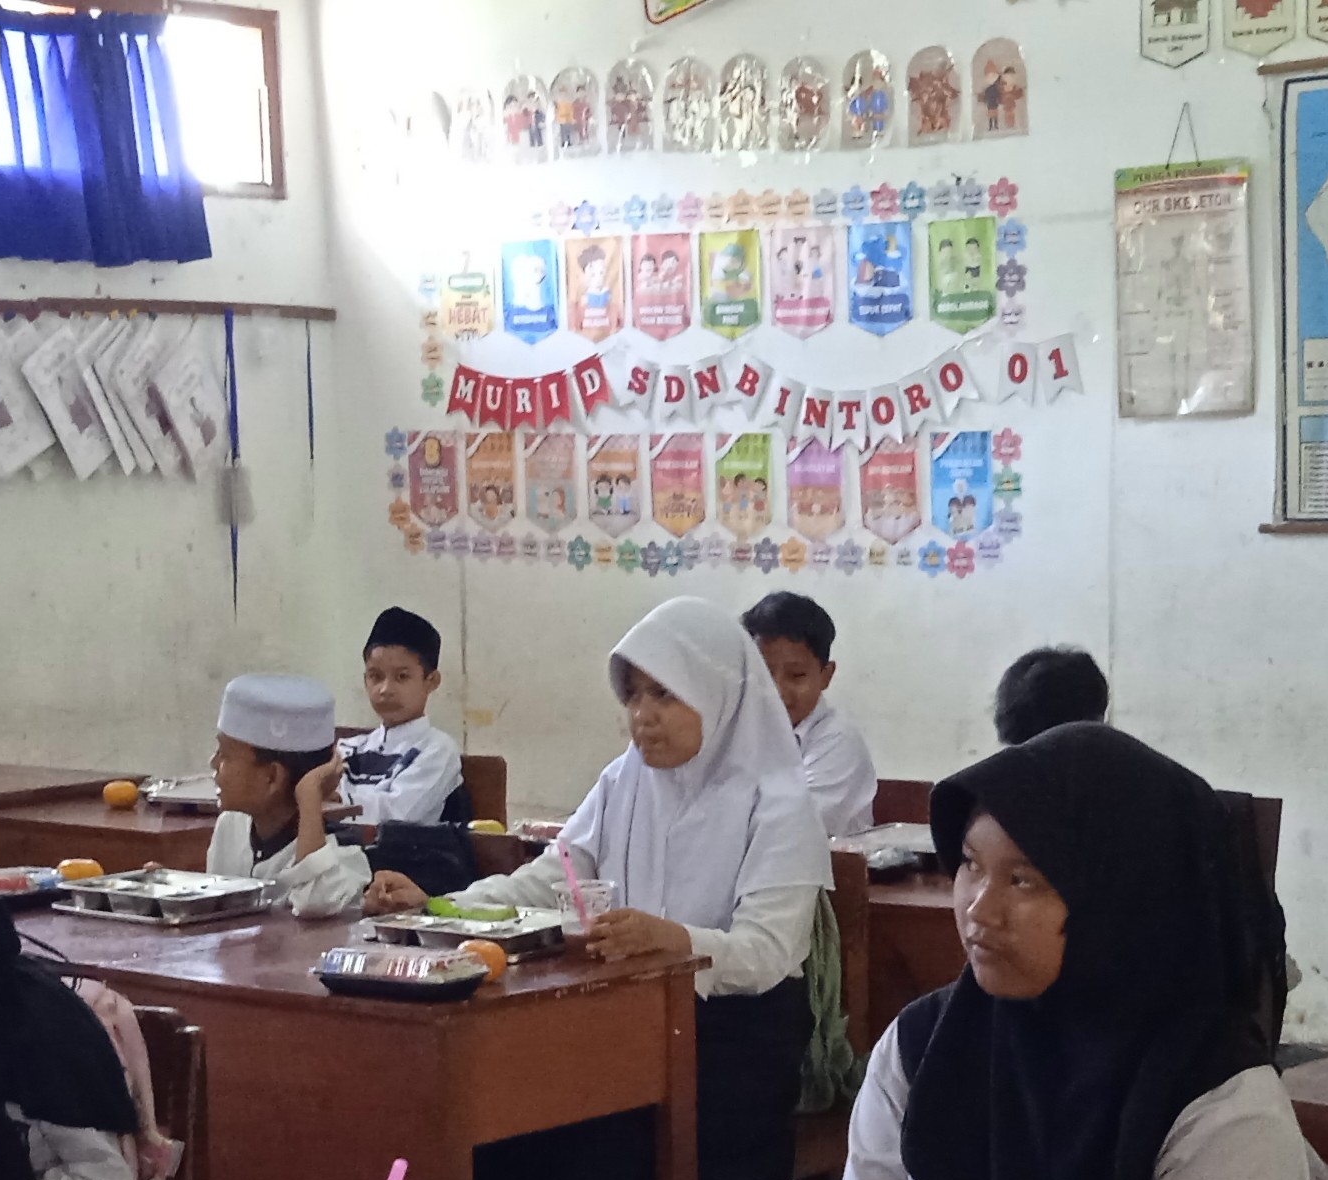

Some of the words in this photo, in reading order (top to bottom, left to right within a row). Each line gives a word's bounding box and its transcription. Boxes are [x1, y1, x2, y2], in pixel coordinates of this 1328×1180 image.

[448, 307, 488, 325] HEBAT
[455, 367, 601, 414] MURID
[1008, 347, 1069, 384] 01
